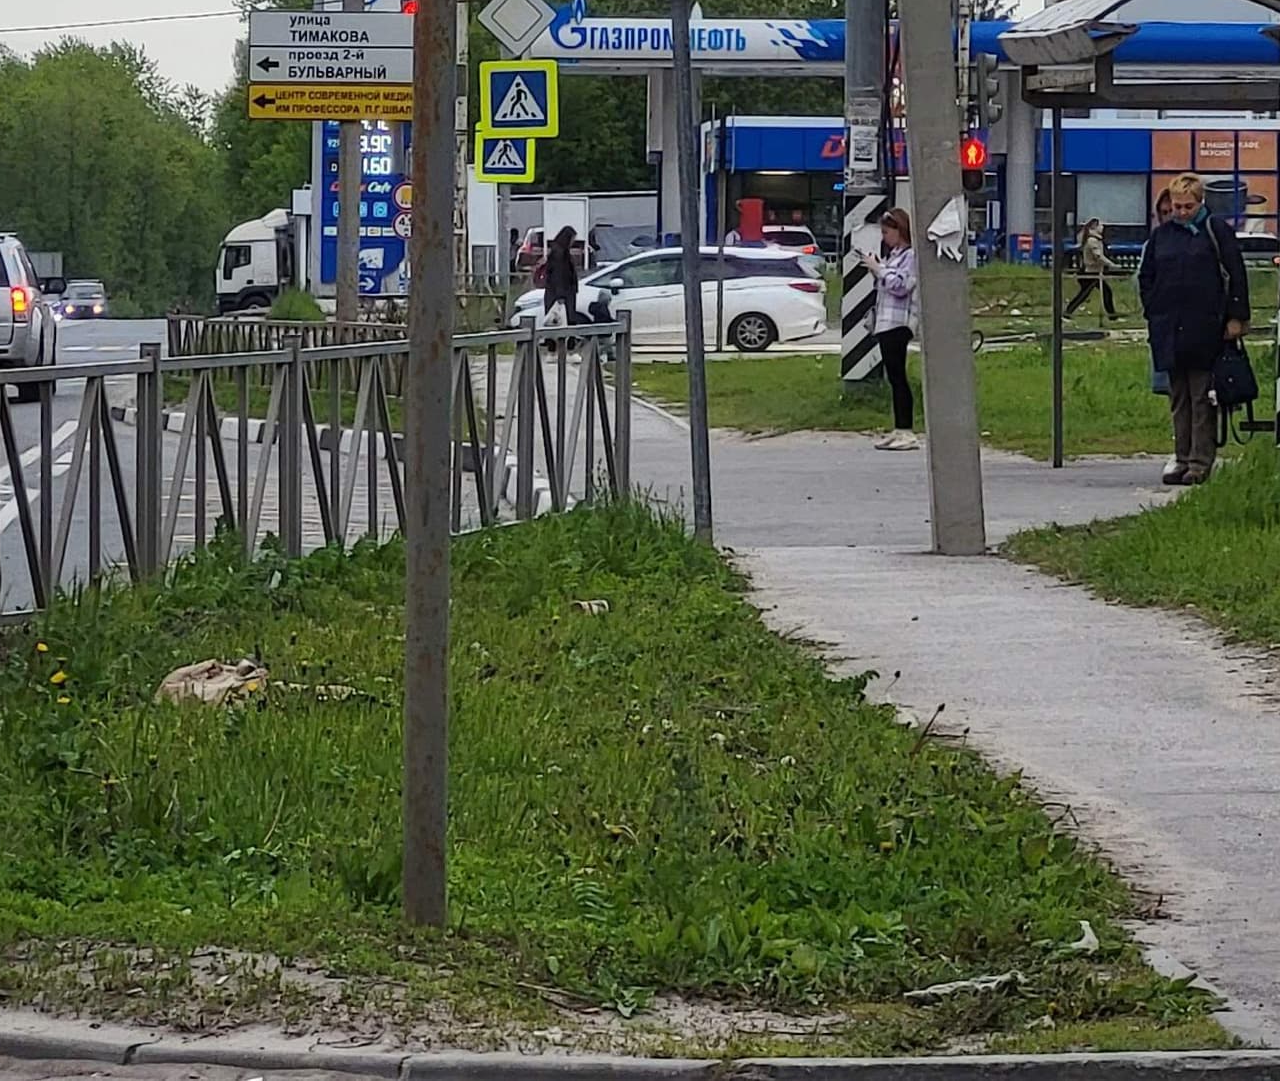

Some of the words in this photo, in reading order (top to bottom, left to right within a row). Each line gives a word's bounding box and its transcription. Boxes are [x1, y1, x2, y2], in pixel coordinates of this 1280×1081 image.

[289, 15, 331, 28] улица
[289, 30, 370, 43] ТИМАКОВА
[288, 49, 340, 62] проезд
[343, 49, 366, 61] 2-й
[288, 64, 387, 79] БУЛЬВАРНЫЙ
[275, 90, 306, 101] ЦЕНТР
[308, 90, 381, 101] СОВРЕМЕННОЙ
[275, 104, 291, 114] ИМ
[292, 104, 361, 114] ПРОФЕССОРА
